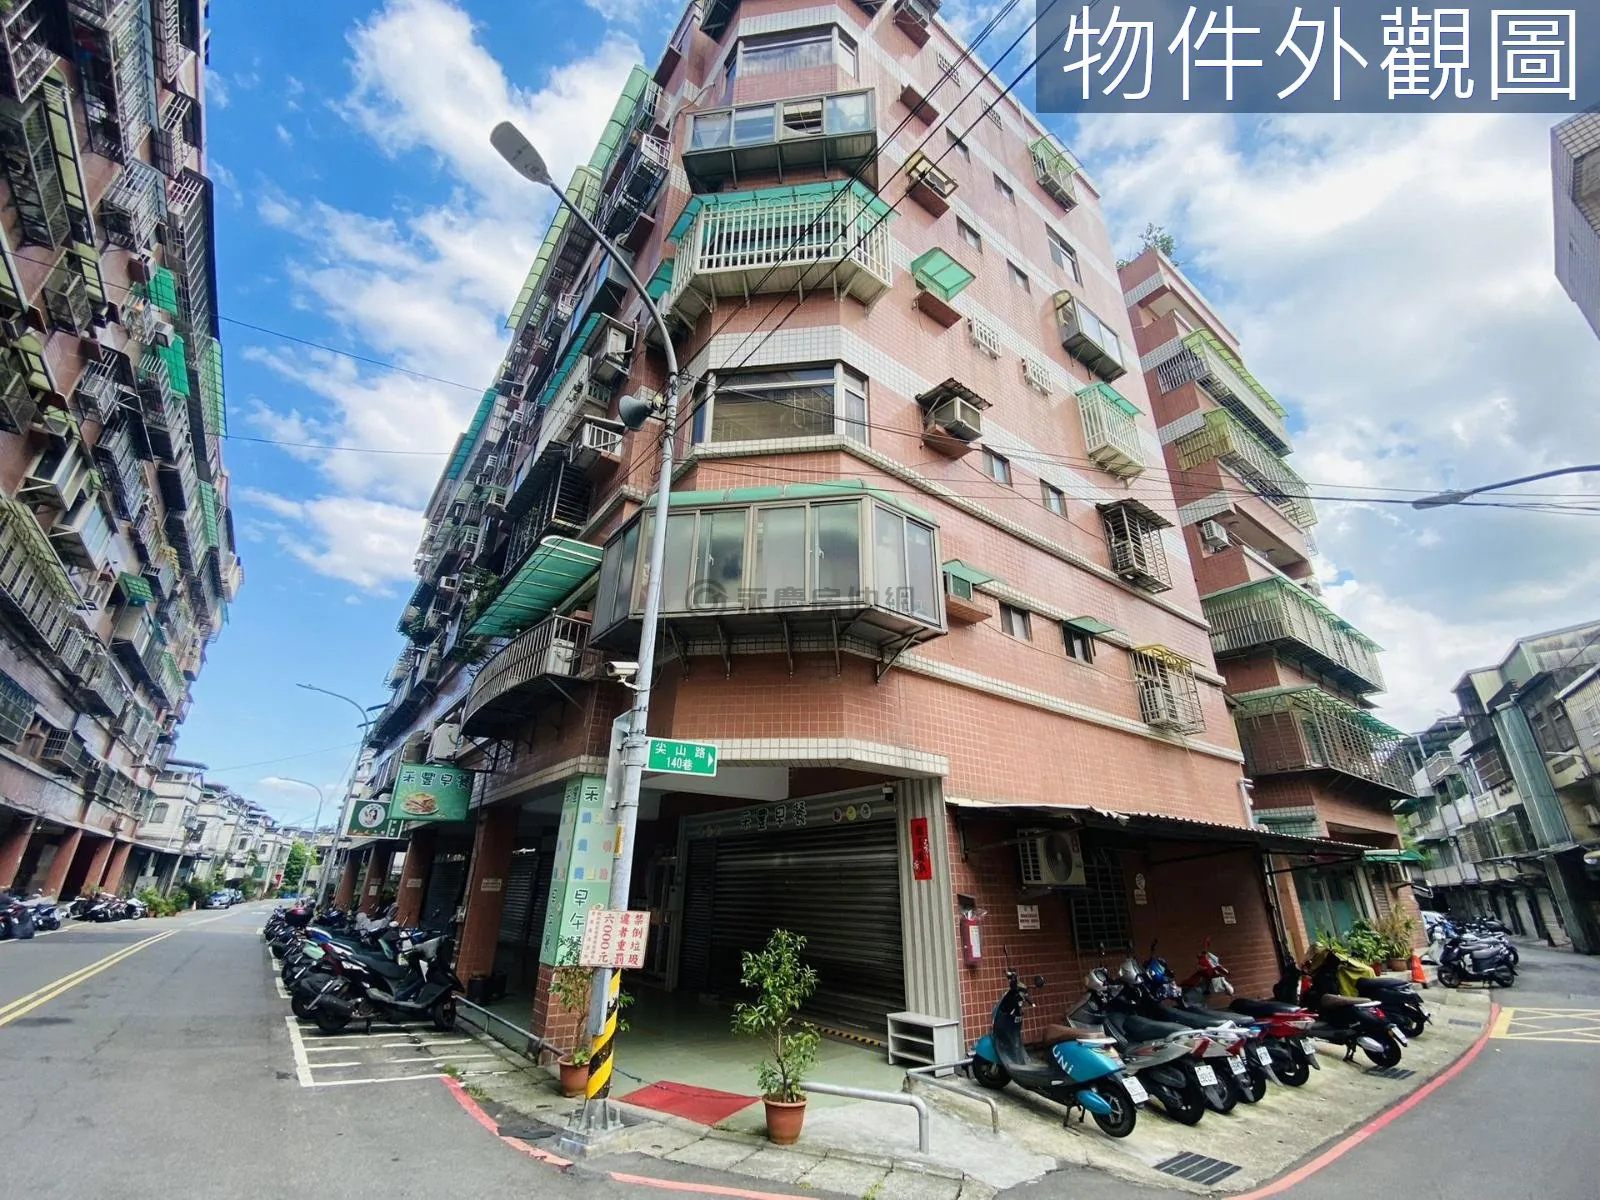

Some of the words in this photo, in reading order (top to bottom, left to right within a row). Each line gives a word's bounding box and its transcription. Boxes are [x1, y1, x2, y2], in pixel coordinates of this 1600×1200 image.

[655, 742, 706, 758] 尖山路
[666, 756, 693, 771] 140巷
[614, 913, 630, 965] 違者重罰
[628, 914, 644, 965] 禁倒垃圾
